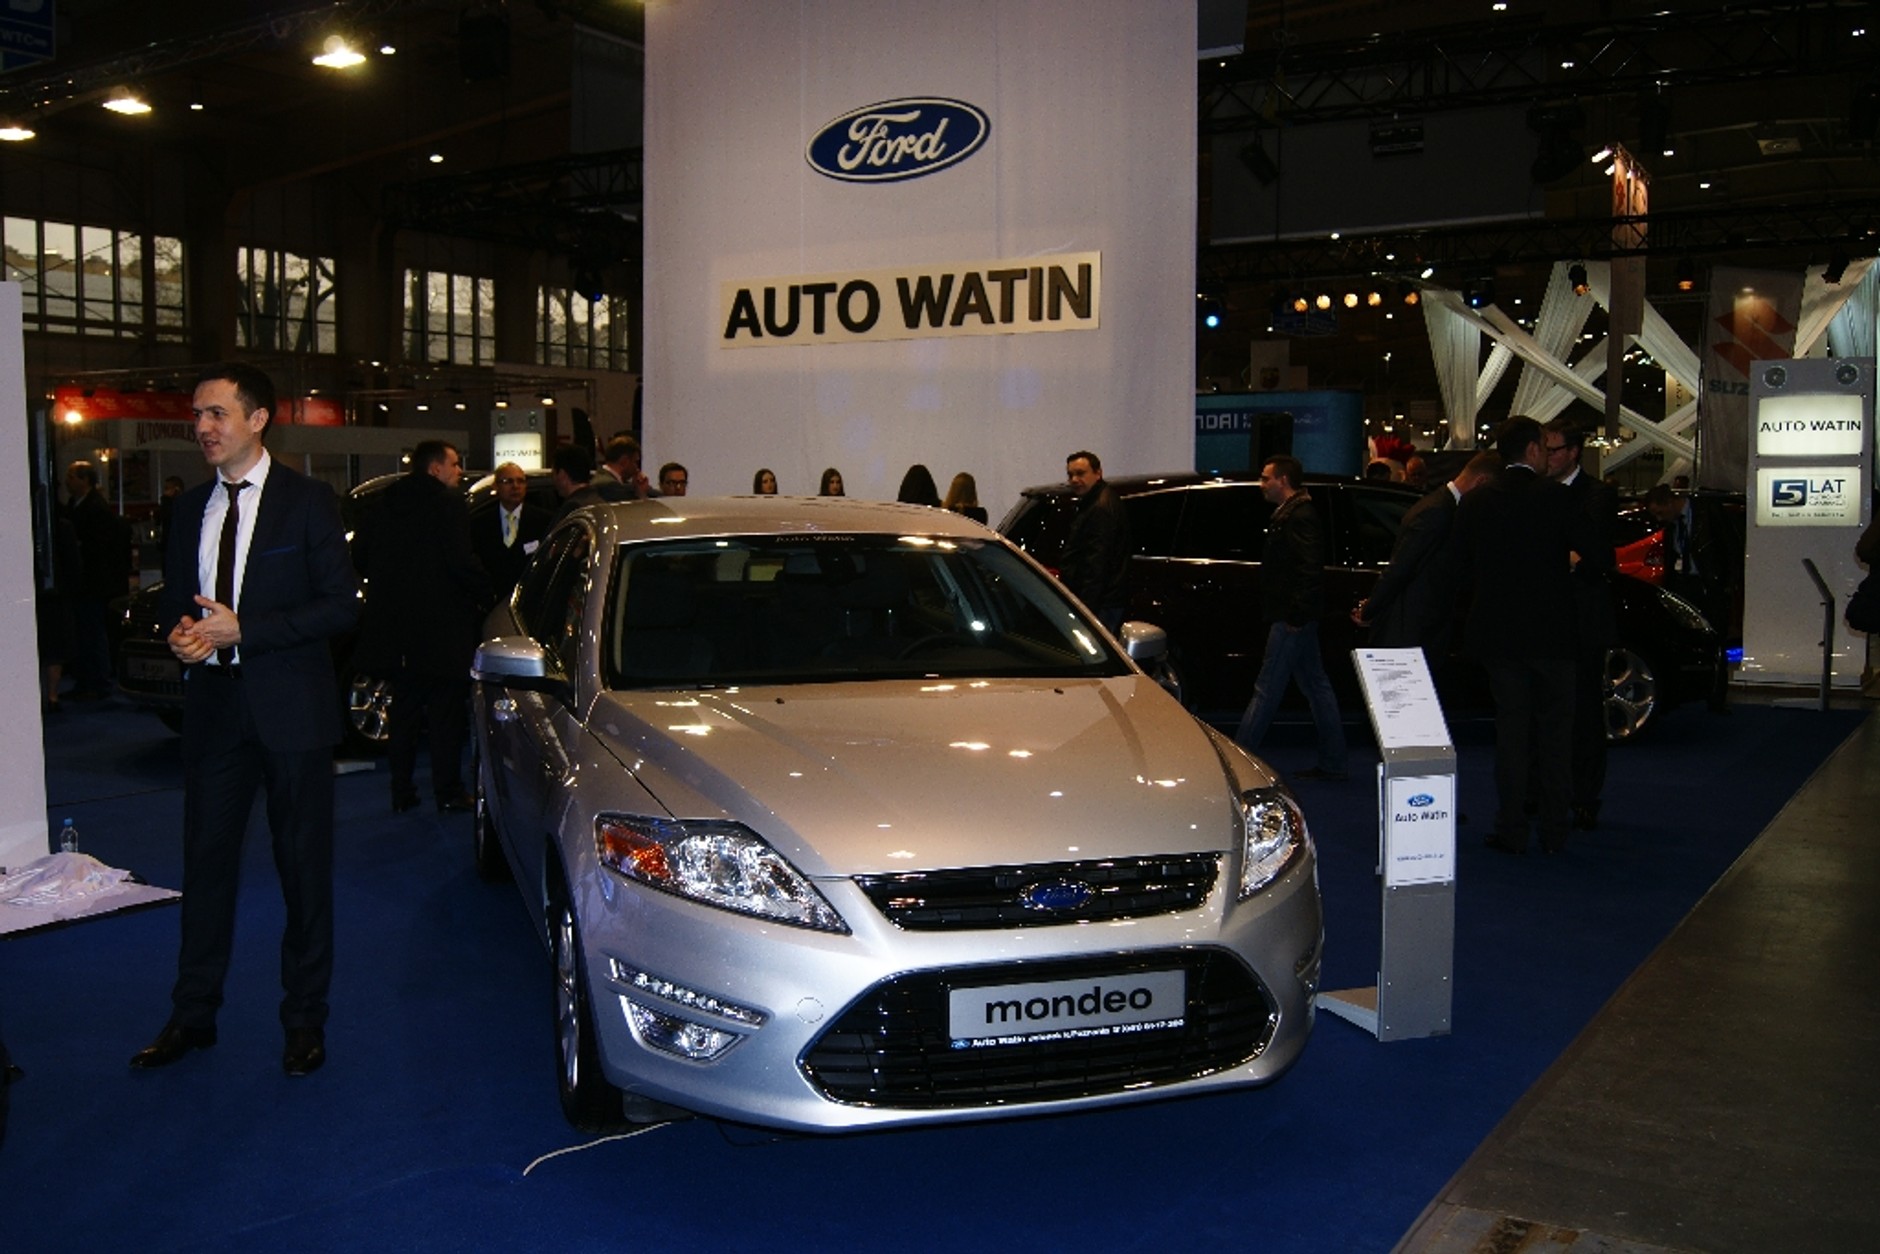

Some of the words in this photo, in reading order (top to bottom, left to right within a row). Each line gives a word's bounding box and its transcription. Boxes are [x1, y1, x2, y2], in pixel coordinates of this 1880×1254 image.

[837, 110, 949, 170] Ford
[724, 279, 881, 339] AUTO
[896, 263, 1093, 330] WATIN
[1709, 379, 1749, 396] SUZ
[1760, 420, 1806, 433] AUTO
[1810, 420, 1862, 432] WATIN
[1774, 482, 1804, 505] 5
[1809, 479, 1846, 493] LAT
[1395, 812, 1418, 822] Auto
[1421, 811, 1448, 821] Watin
[985, 986, 1153, 1024] mondeo
[971, 1037, 996, 1048] Auto
